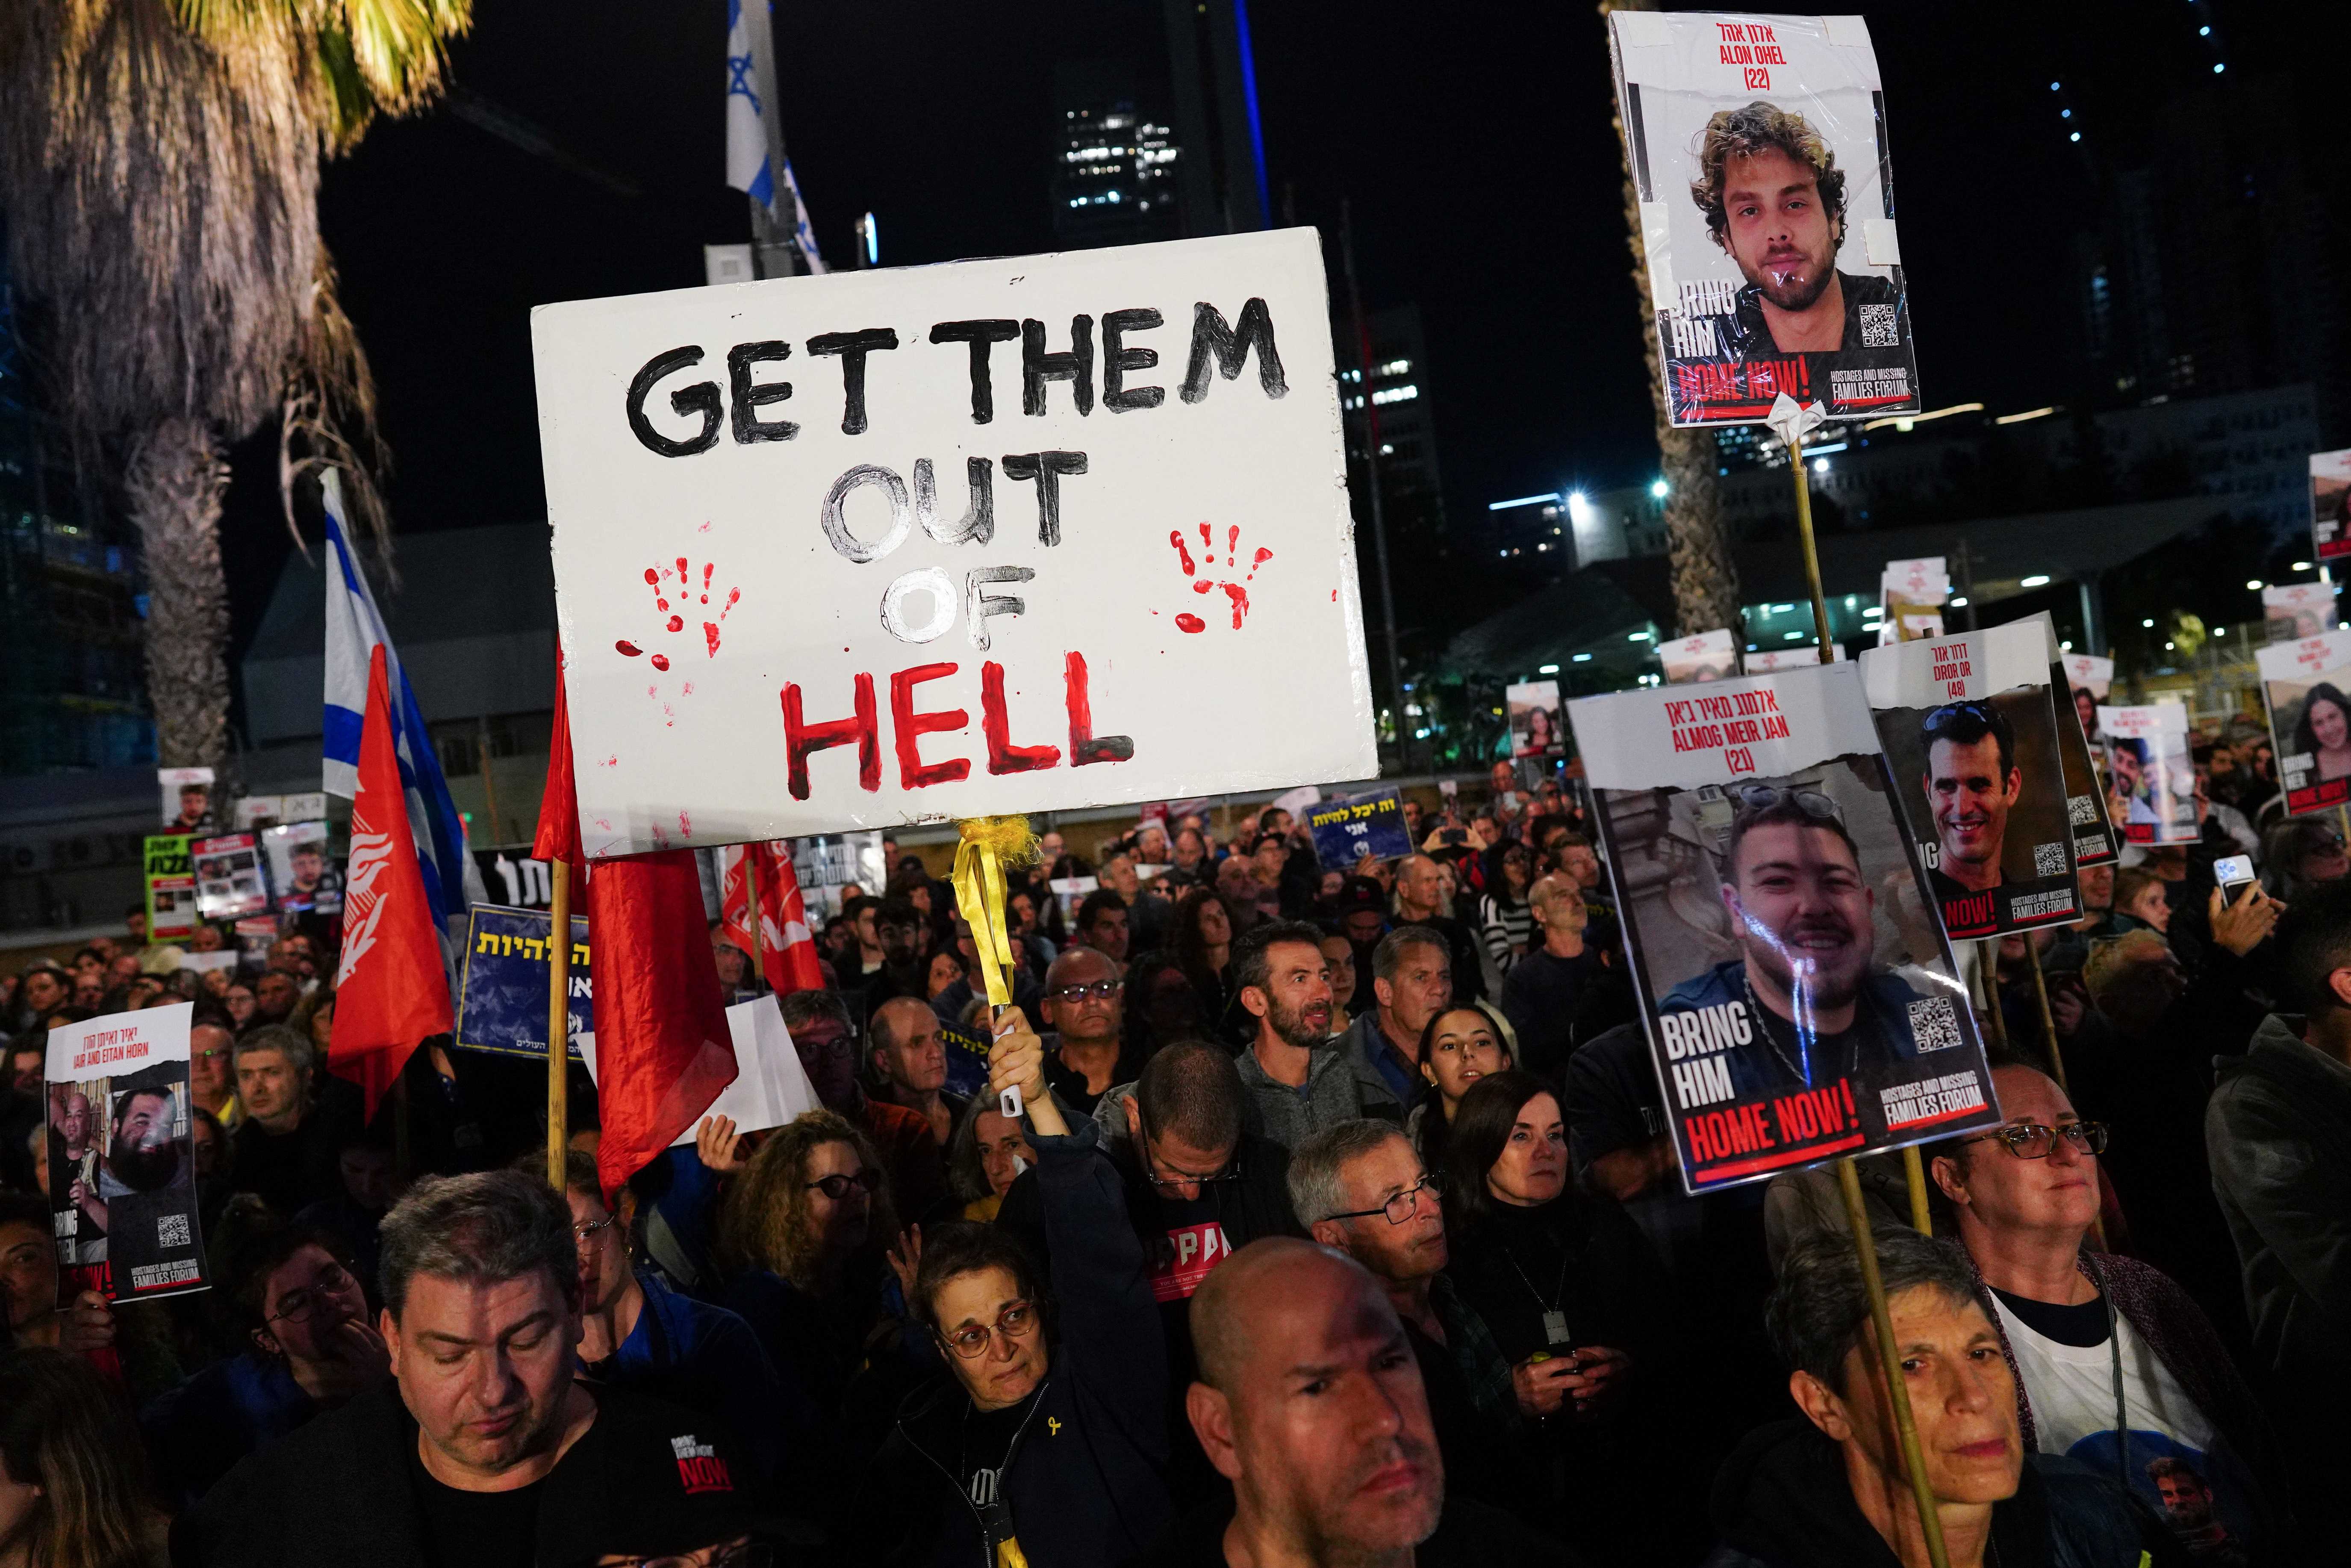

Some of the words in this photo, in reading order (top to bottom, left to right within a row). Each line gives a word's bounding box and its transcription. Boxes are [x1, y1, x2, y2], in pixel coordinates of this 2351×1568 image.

[1716, 23, 1746, 41] אהל
[1745, 24, 1777, 44] אלון
[1720, 45, 1753, 64] ALON
[1754, 45, 1787, 64] OHEL
[1744, 67, 1770, 91] (22)
[1670, 319, 1718, 358] HIM
[627, 327, 899, 458] GET
[929, 297, 1290, 424] THEM
[1677, 363, 1743, 403] HOME
[1746, 355, 1810, 400] NOW!
[1831, 370, 1862, 382] HOSTAGES
[1864, 369, 1877, 381] AND
[1877, 367, 1907, 380] MISSING
[1832, 382, 1874, 400] FAMILIES
[1874, 379, 1909, 398] FORUM
[821, 450, 1088, 563] OUT
[880, 565, 1036, 652] OF
[1931, 646, 1949, 662] אור
[1949, 643, 1968, 659] דרור
[1933, 663, 1959, 681] DROR
[1959, 661, 1972, 677] OR
[1947, 680, 1965, 699] (48)
[1695, 696, 1734, 721] מאיר
[1732, 690, 1779, 716] אלמוג
[781, 650, 1135, 801] HELL
[1672, 724, 1723, 753] ALMOG
[1722, 720, 1762, 745] MEIR
[1762, 715, 1791, 739] JAN
[1725, 747, 1755, 775] (21)
[1378, 798, 1396, 813] זה
[1345, 821, 1368, 836] אני
[1945, 890, 1995, 927] NOW!
[2011, 894, 2038, 907] HOSTAGES
[2038, 892, 2049, 902] AND
[2049, 888, 2071, 900] MISSING
[2012, 902, 2046, 920] FAMILIES
[2047, 897, 2073, 914] FORUM
[1659, 1000, 1753, 1061] BRING
[87, 1050, 100, 1066] AND
[102, 1046, 124, 1063] EITAN
[126, 1041, 148, 1059] HORN
[1671, 1055, 1735, 1109] HIM
[1880, 1082, 1923, 1104] HOSTAGES
[1922, 1078, 1941, 1095] AND
[1939, 1070, 1978, 1091] MISSING
[1883, 1094, 1940, 1126] FAMILIES
[1938, 1084, 1985, 1114] FORUM
[1685, 1102, 1776, 1163] HOME
[1773, 1077, 1859, 1144] NOW!
[54, 1209, 78, 1237] BRING
[131, 1264, 159, 1276] HOSTAGES
[160, 1262, 171, 1272] AND
[171, 1259, 198, 1270] MISSING
[133, 1271, 170, 1289] FAMILIES
[171, 1267, 199, 1284] FORUM
[677, 1456, 730, 1487] NOW
